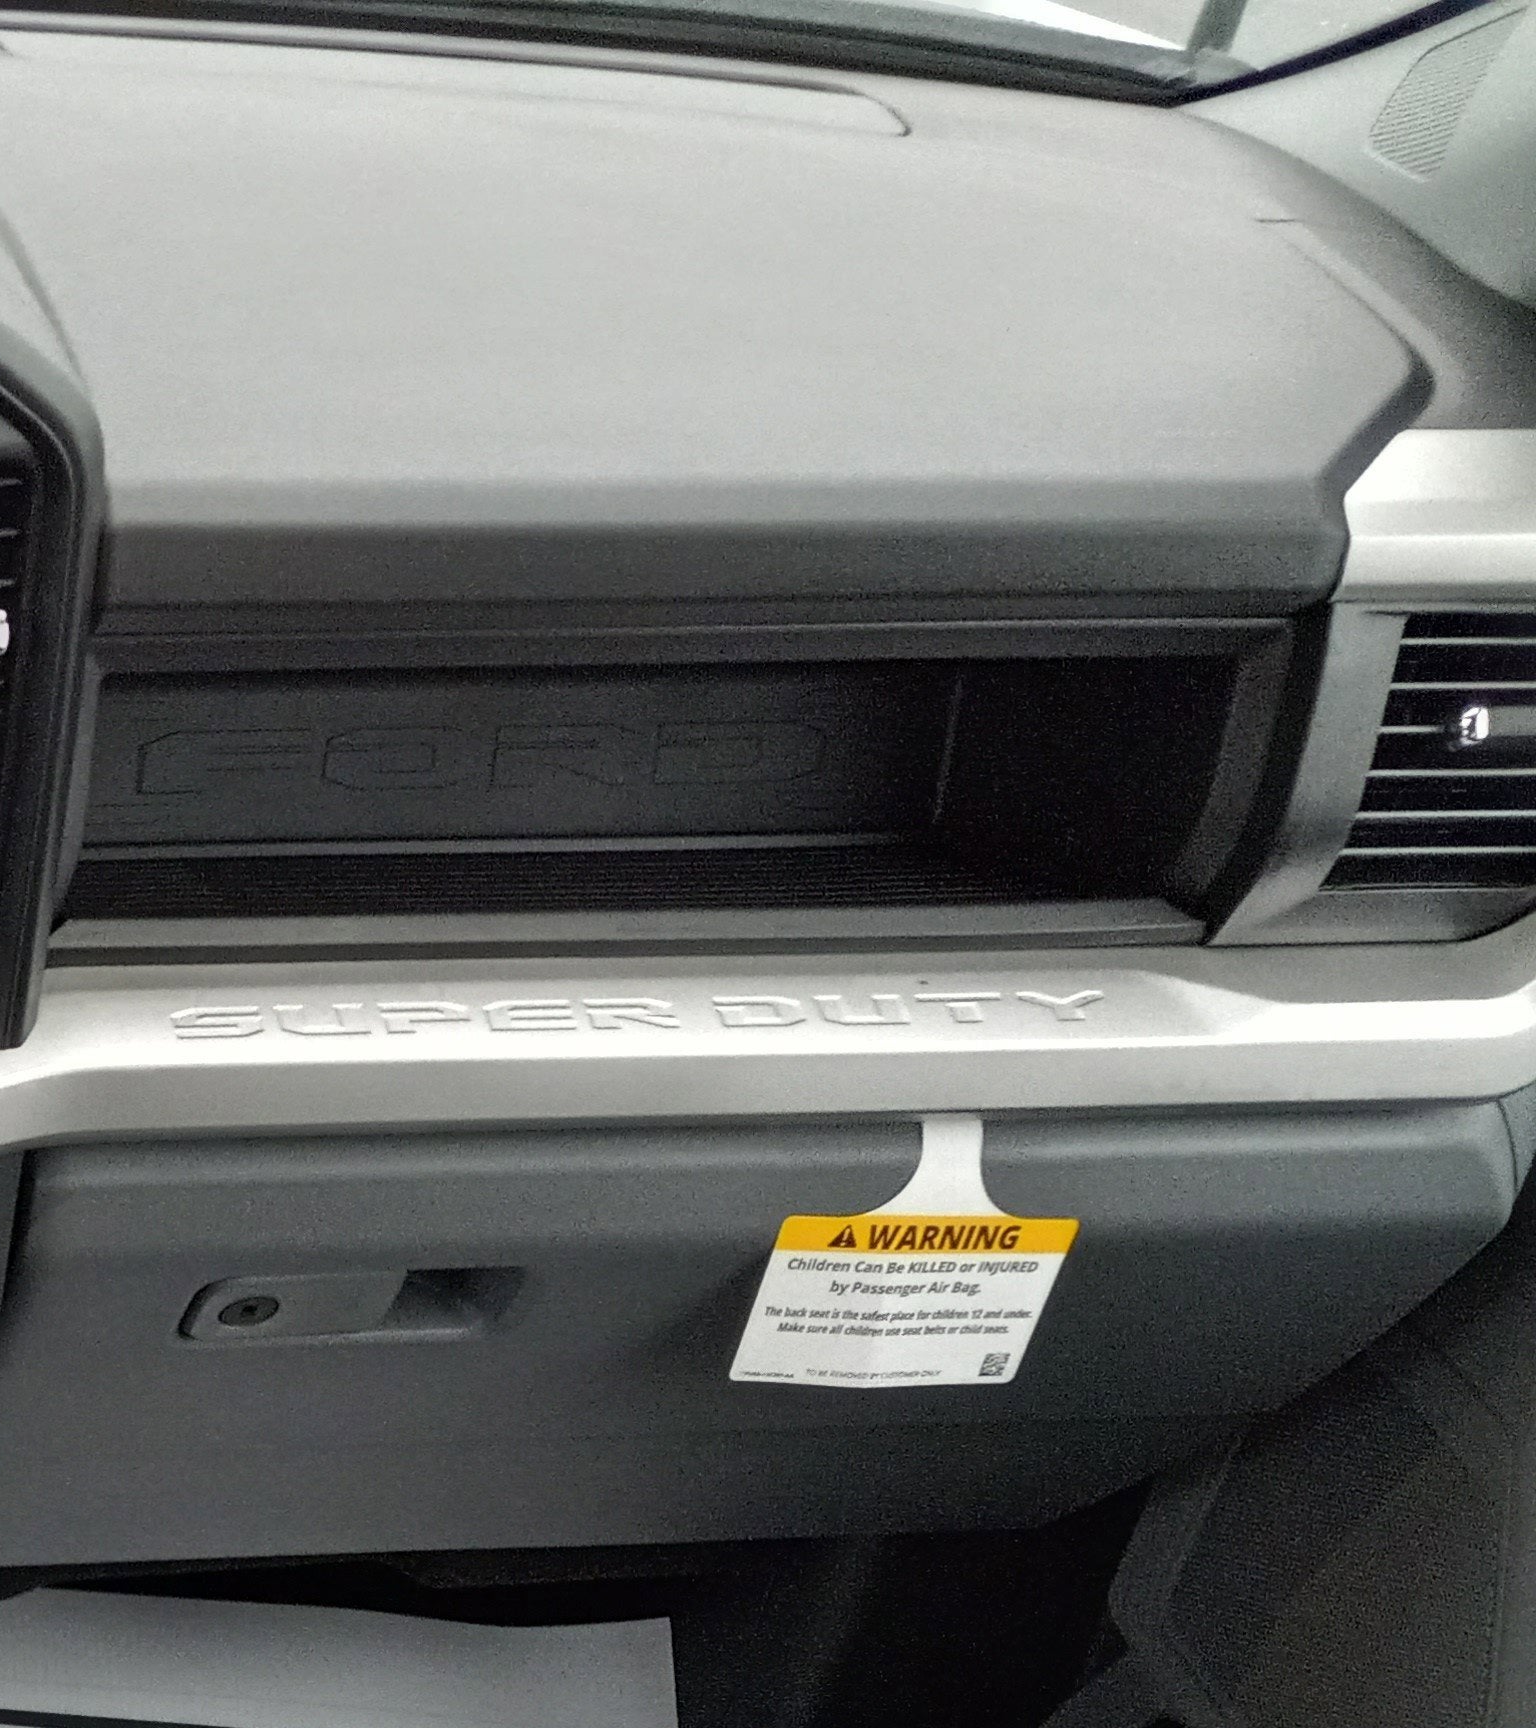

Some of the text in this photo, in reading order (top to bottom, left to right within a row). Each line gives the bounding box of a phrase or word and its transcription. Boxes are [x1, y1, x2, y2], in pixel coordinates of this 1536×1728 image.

[135, 718, 826, 796] FORD
[170, 989, 1105, 1040] SUPER DUTY
[867, 1224, 1022, 1251] WARNING
[787, 1258, 1039, 1276] Children Can Be KILLED or INJURED
[829, 1280, 982, 1298] by Passenger Air Bag.
[765, 1306, 783, 1317] The
[784, 1307, 807, 1317] back
[808, 1309, 830, 1319] seat
[831, 1308, 840, 1319] is
[841, 1308, 859, 1320] the
[860, 1310, 889, 1321] safest
[890, 1310, 915, 1322] place
[916, 1310, 931, 1320] for
[931, 1309, 969, 1319] children
[971, 1309, 983, 1319] 12
[983, 1309, 1003, 1319] and
[777, 1323, 805, 1333] Make
[806, 1324, 828, 1334] sure
[829, 1324, 844, 1335] all
[844, 1325, 883, 1337] children
[885, 1327, 901, 1336] use
[901, 1327, 923, 1336] seat
[959, 1325, 983, 1335] child
